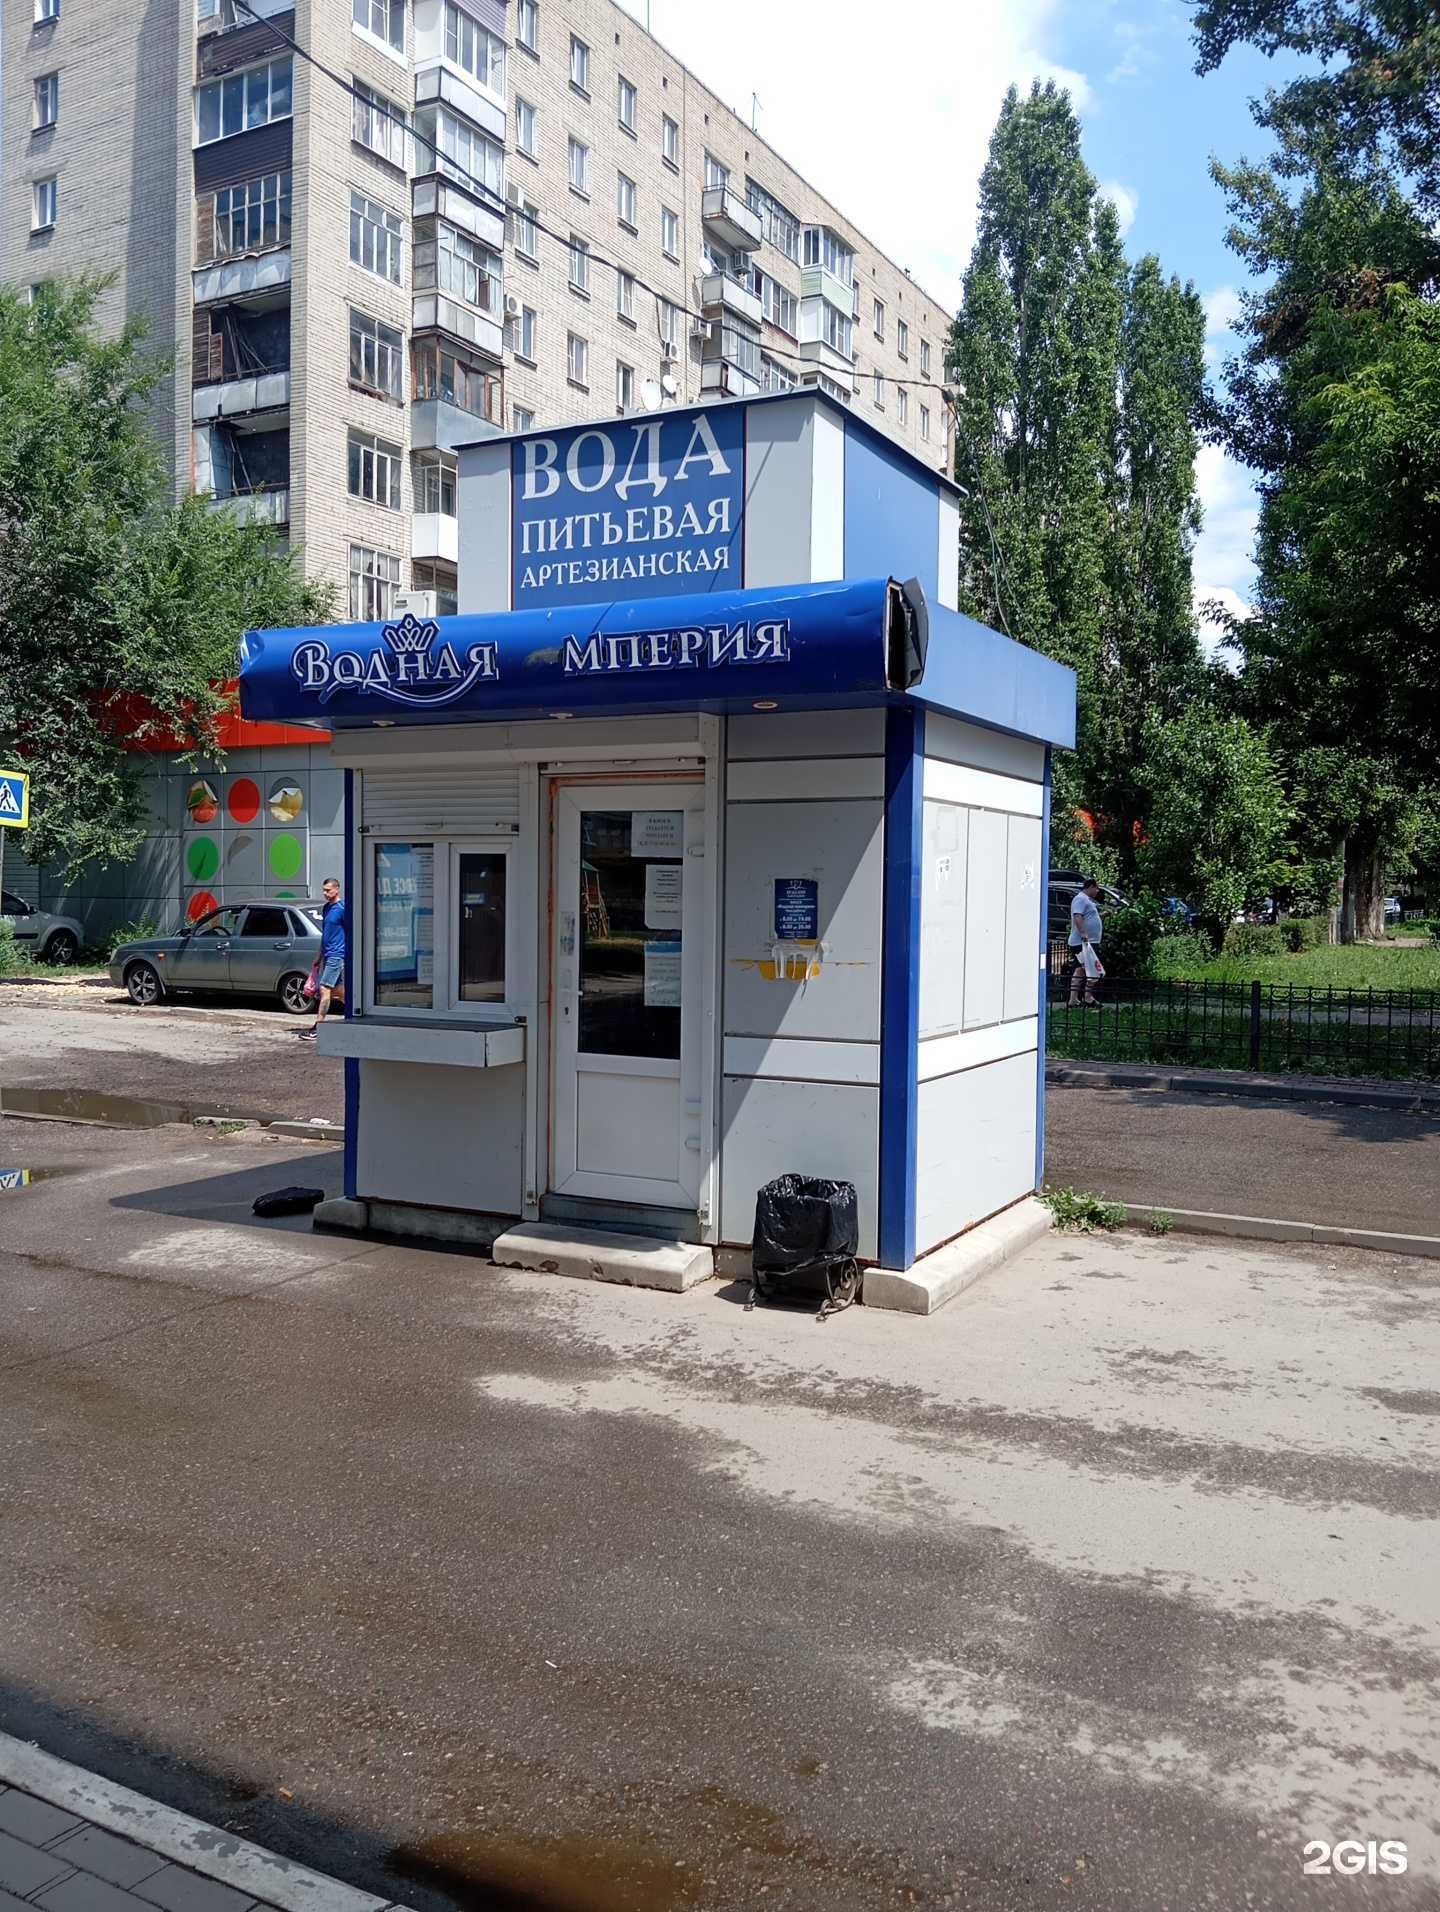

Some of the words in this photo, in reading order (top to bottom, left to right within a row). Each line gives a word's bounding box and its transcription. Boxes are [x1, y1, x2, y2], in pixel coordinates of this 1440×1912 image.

[522, 414, 731, 500] ВОДА
[521, 497, 731, 553] ПИТЬЕВАЯ
[520, 546, 730, 588] АРТЕЗИАНСКАЯ
[562, 618, 790, 675] МПЕРИЯ
